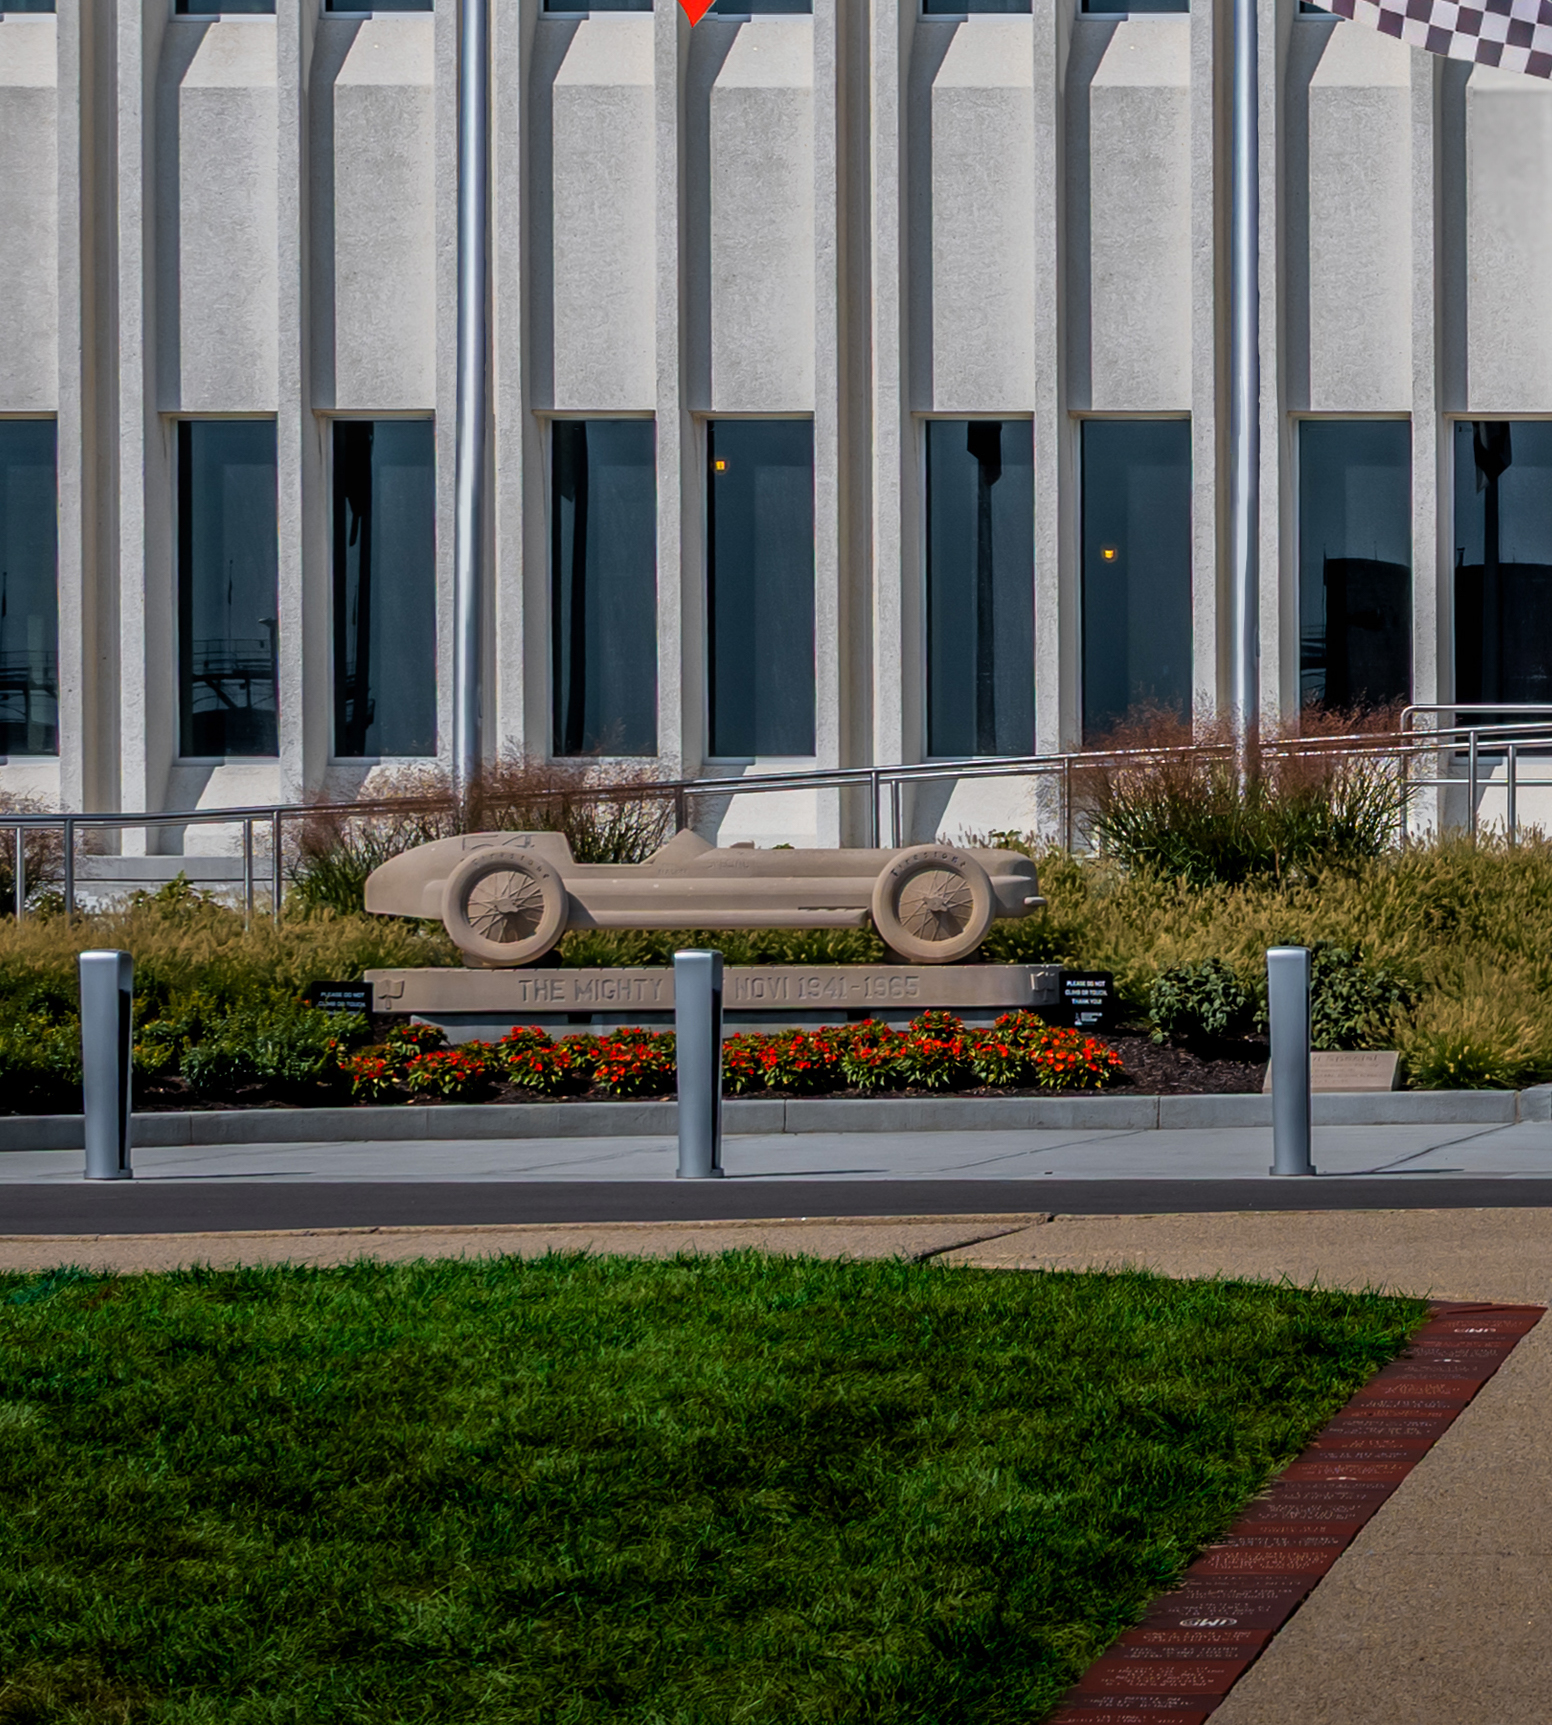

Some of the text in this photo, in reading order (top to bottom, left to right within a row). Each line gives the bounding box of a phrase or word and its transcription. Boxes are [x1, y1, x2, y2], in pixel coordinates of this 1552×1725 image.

[518, 975, 921, 1003] THE MIGHTY NOVI 1941-1965
